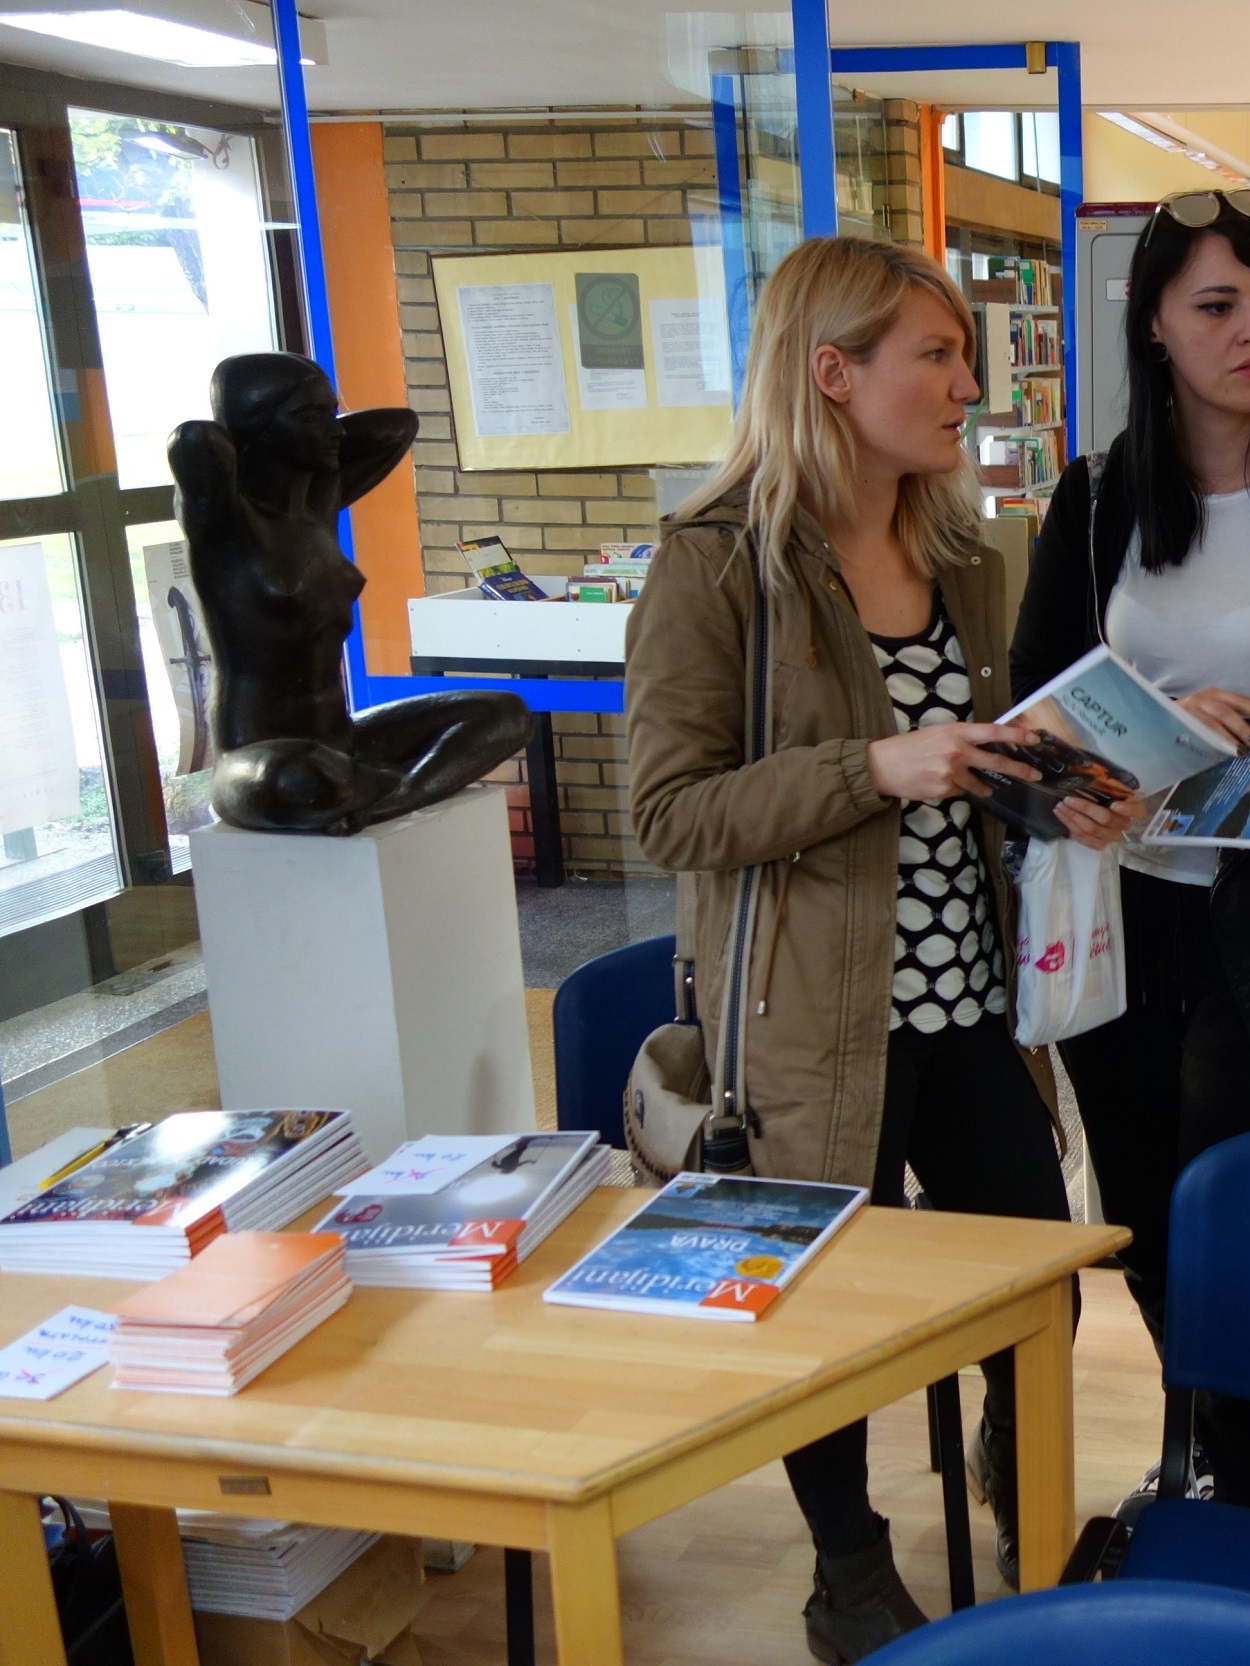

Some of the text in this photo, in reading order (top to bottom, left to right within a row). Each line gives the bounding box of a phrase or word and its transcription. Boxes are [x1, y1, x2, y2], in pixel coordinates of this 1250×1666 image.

[1070, 685, 1129, 739] CAPTUR
[338, 1220, 504, 1247] Meridija
[669, 1233, 751, 1253] DRAVA
[566, 1266, 757, 1303] Meridijani
